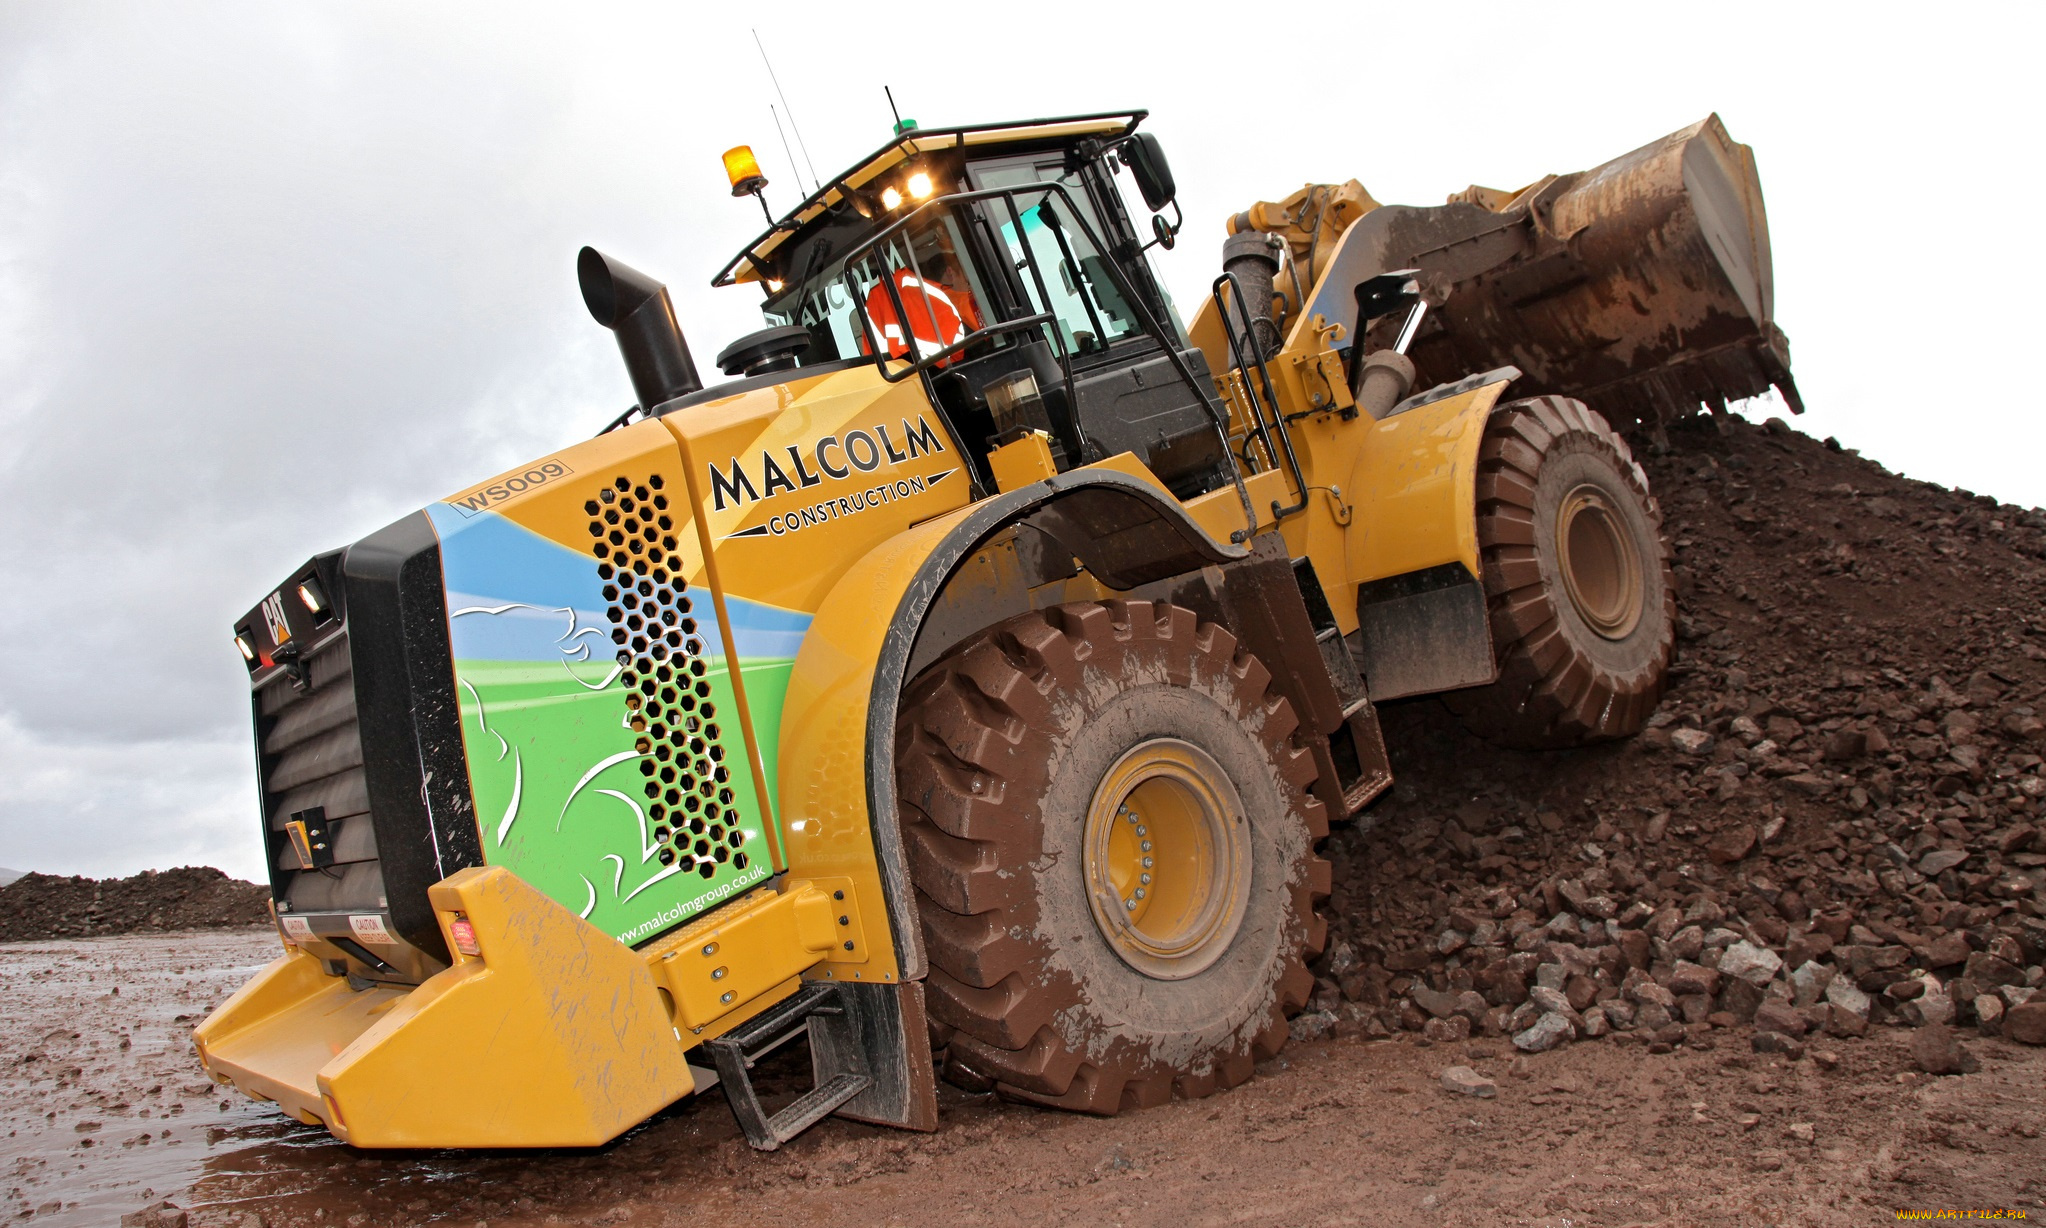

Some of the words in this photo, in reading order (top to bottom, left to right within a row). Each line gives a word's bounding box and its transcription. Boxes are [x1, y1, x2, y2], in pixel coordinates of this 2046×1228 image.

[708, 414, 945, 511] MALCOLM
[769, 475, 926, 536] CONSTRUCTION
[262, 590, 292, 646] CAT
[356, 919, 380, 930] CAUTION
